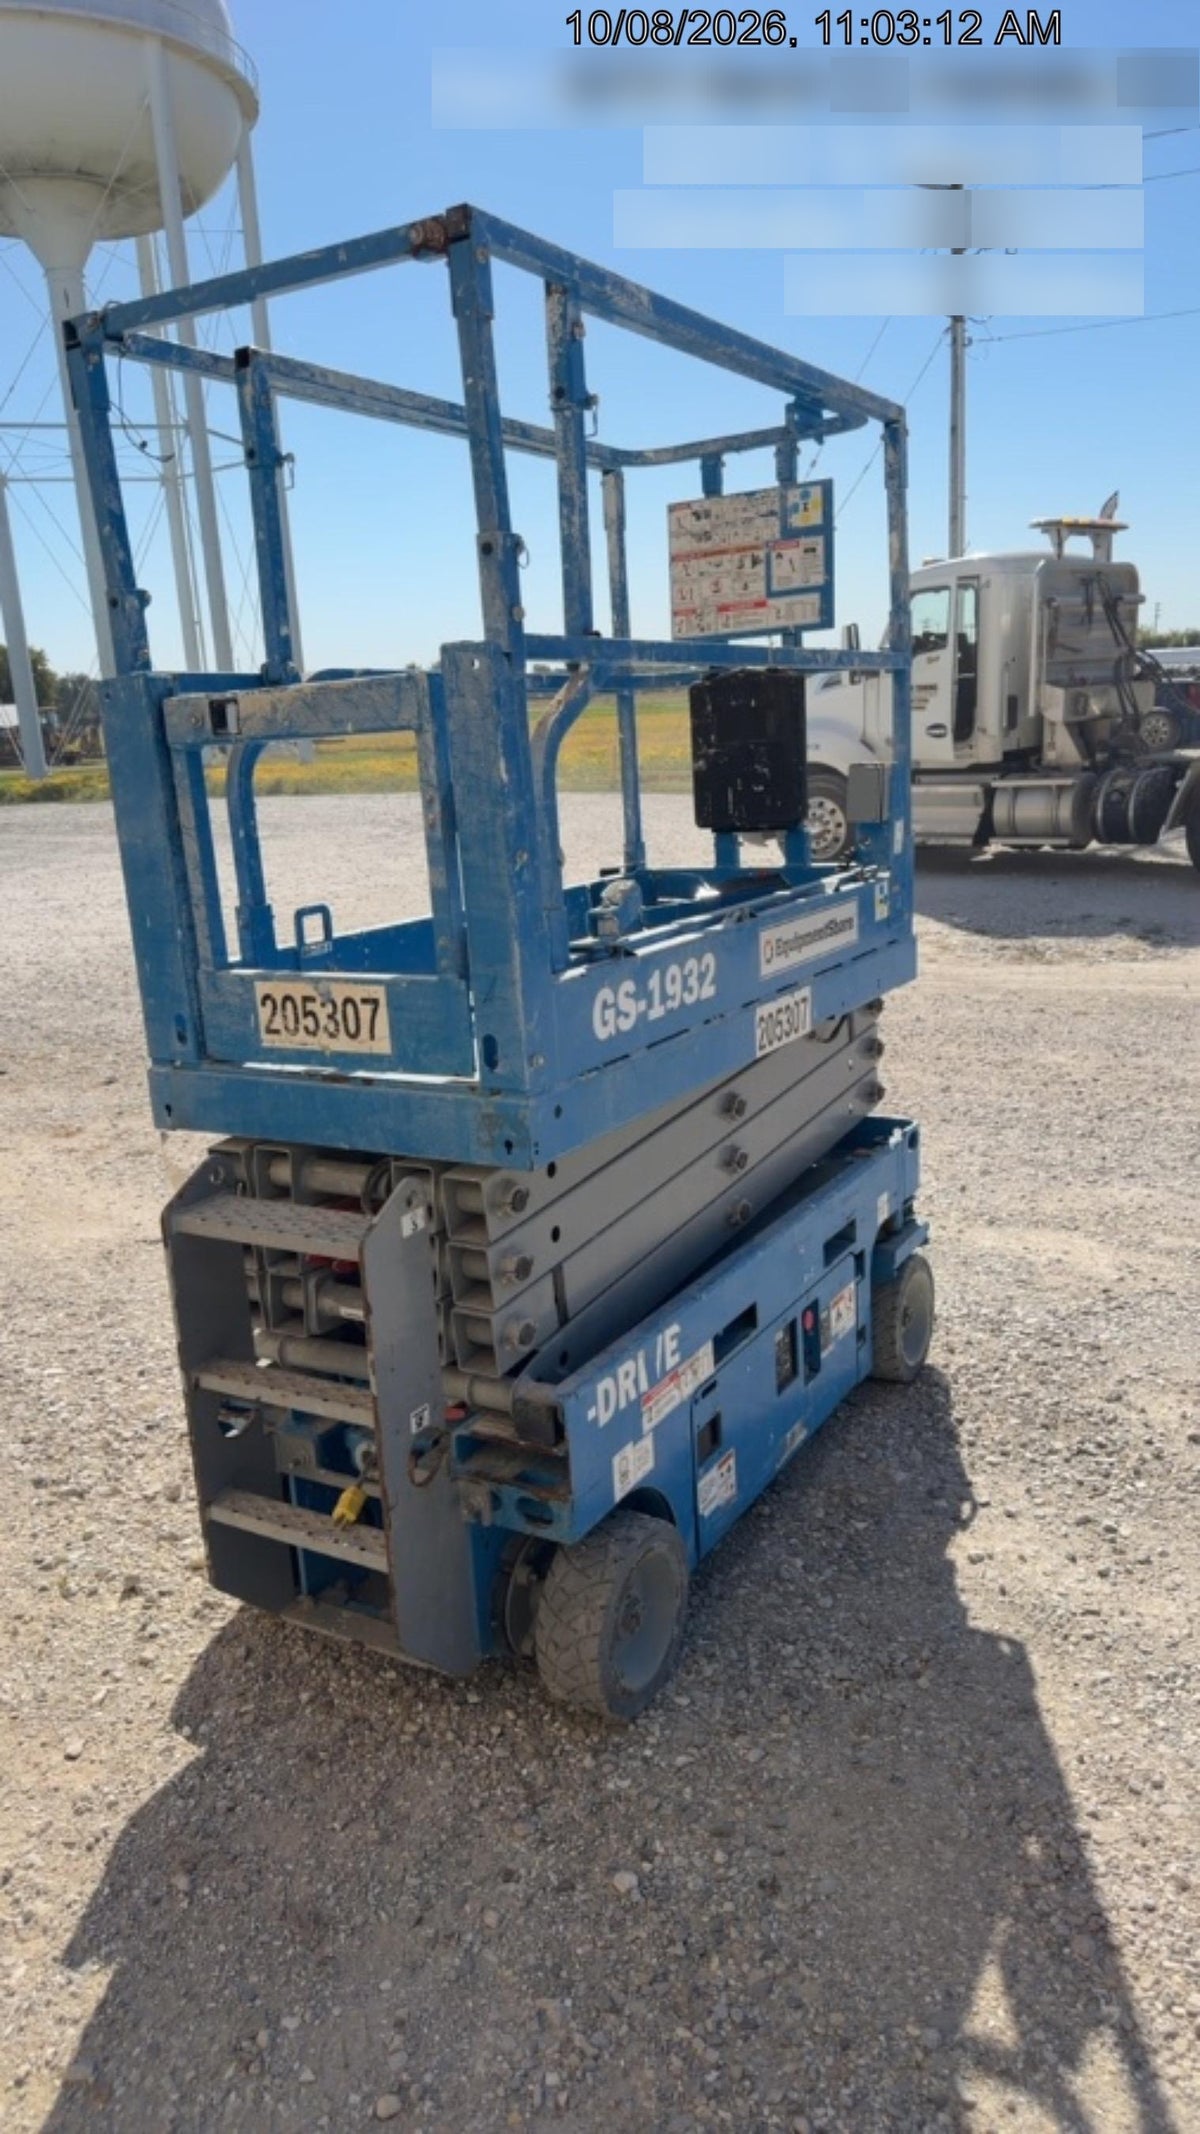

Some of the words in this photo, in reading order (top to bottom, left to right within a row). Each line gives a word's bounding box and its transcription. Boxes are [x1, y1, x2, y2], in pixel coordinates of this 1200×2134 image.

[260, 993, 380, 1041] 205307
[592, 953, 716, 1040] GS-1932
[758, 995, 808, 1051] 205307
